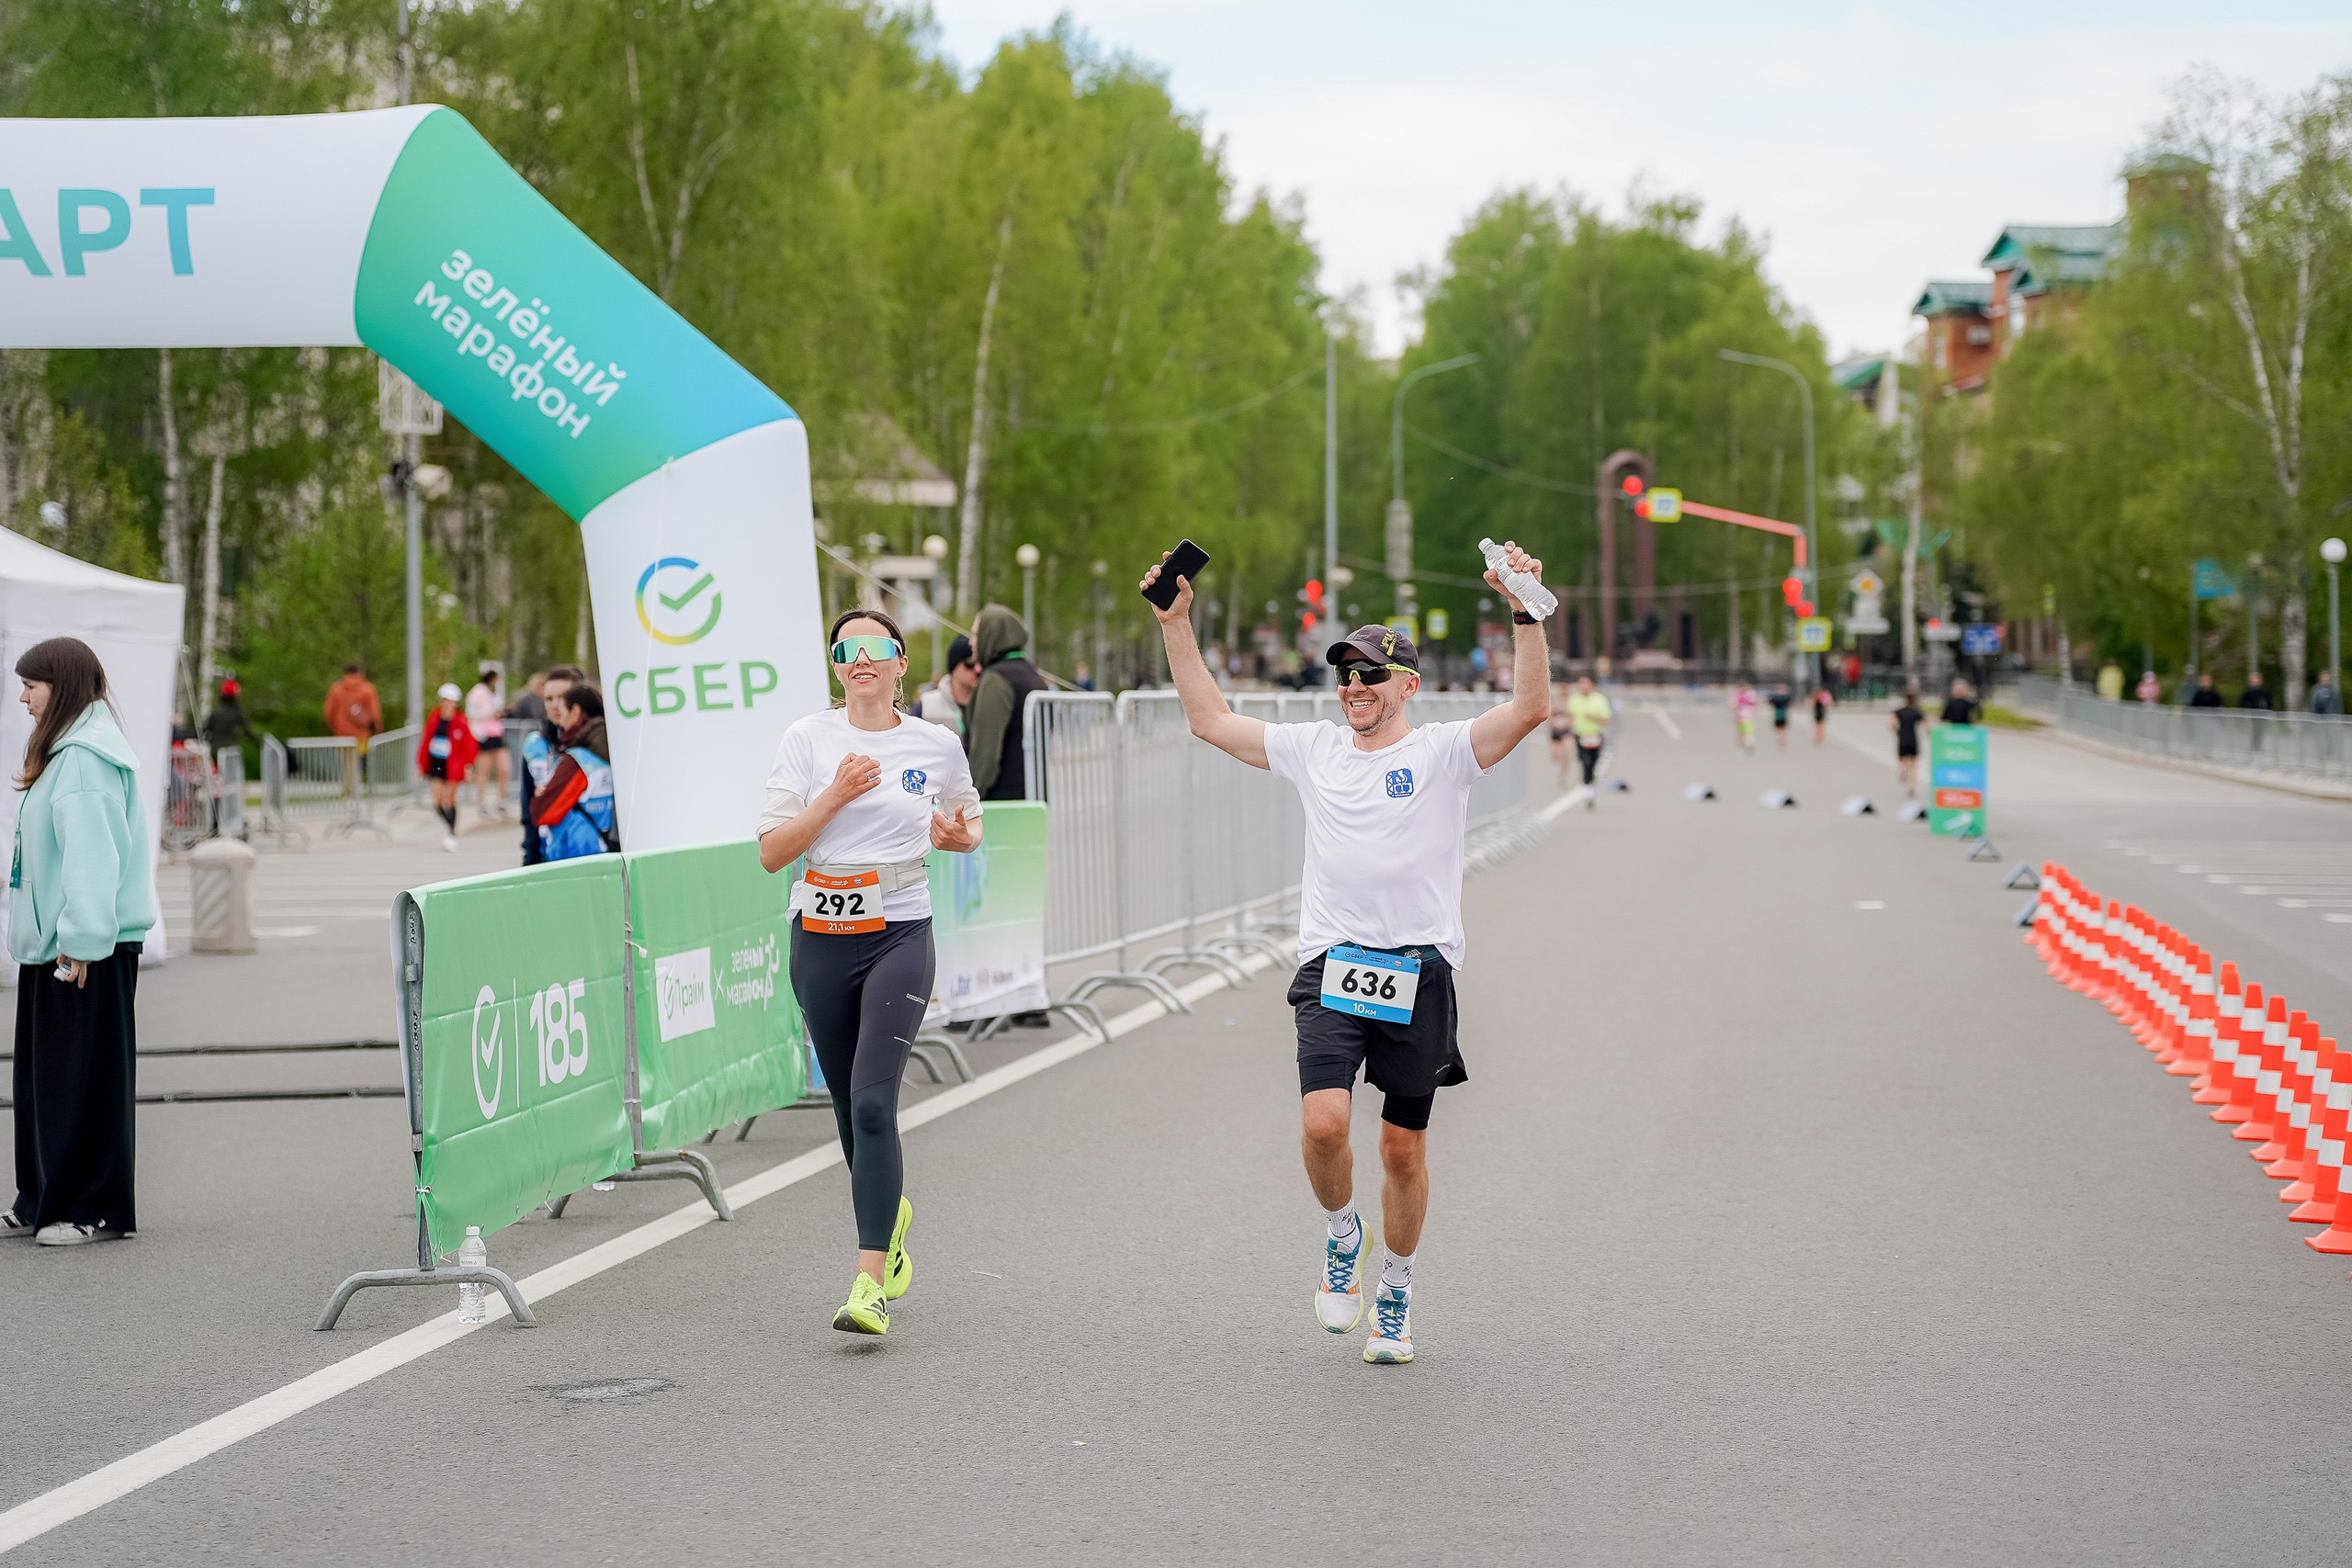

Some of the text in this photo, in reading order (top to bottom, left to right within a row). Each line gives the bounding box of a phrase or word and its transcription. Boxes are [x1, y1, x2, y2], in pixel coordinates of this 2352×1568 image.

[440, 248, 628, 407] зелёный
[413, 279, 592, 439] марафон
[614, 660, 778, 719] СБЕР
[815, 892, 865, 916] 292
[674, 973, 705, 1016] Прайм
[1340, 968, 1396, 1000] 636
[529, 977, 589, 1088] 185
